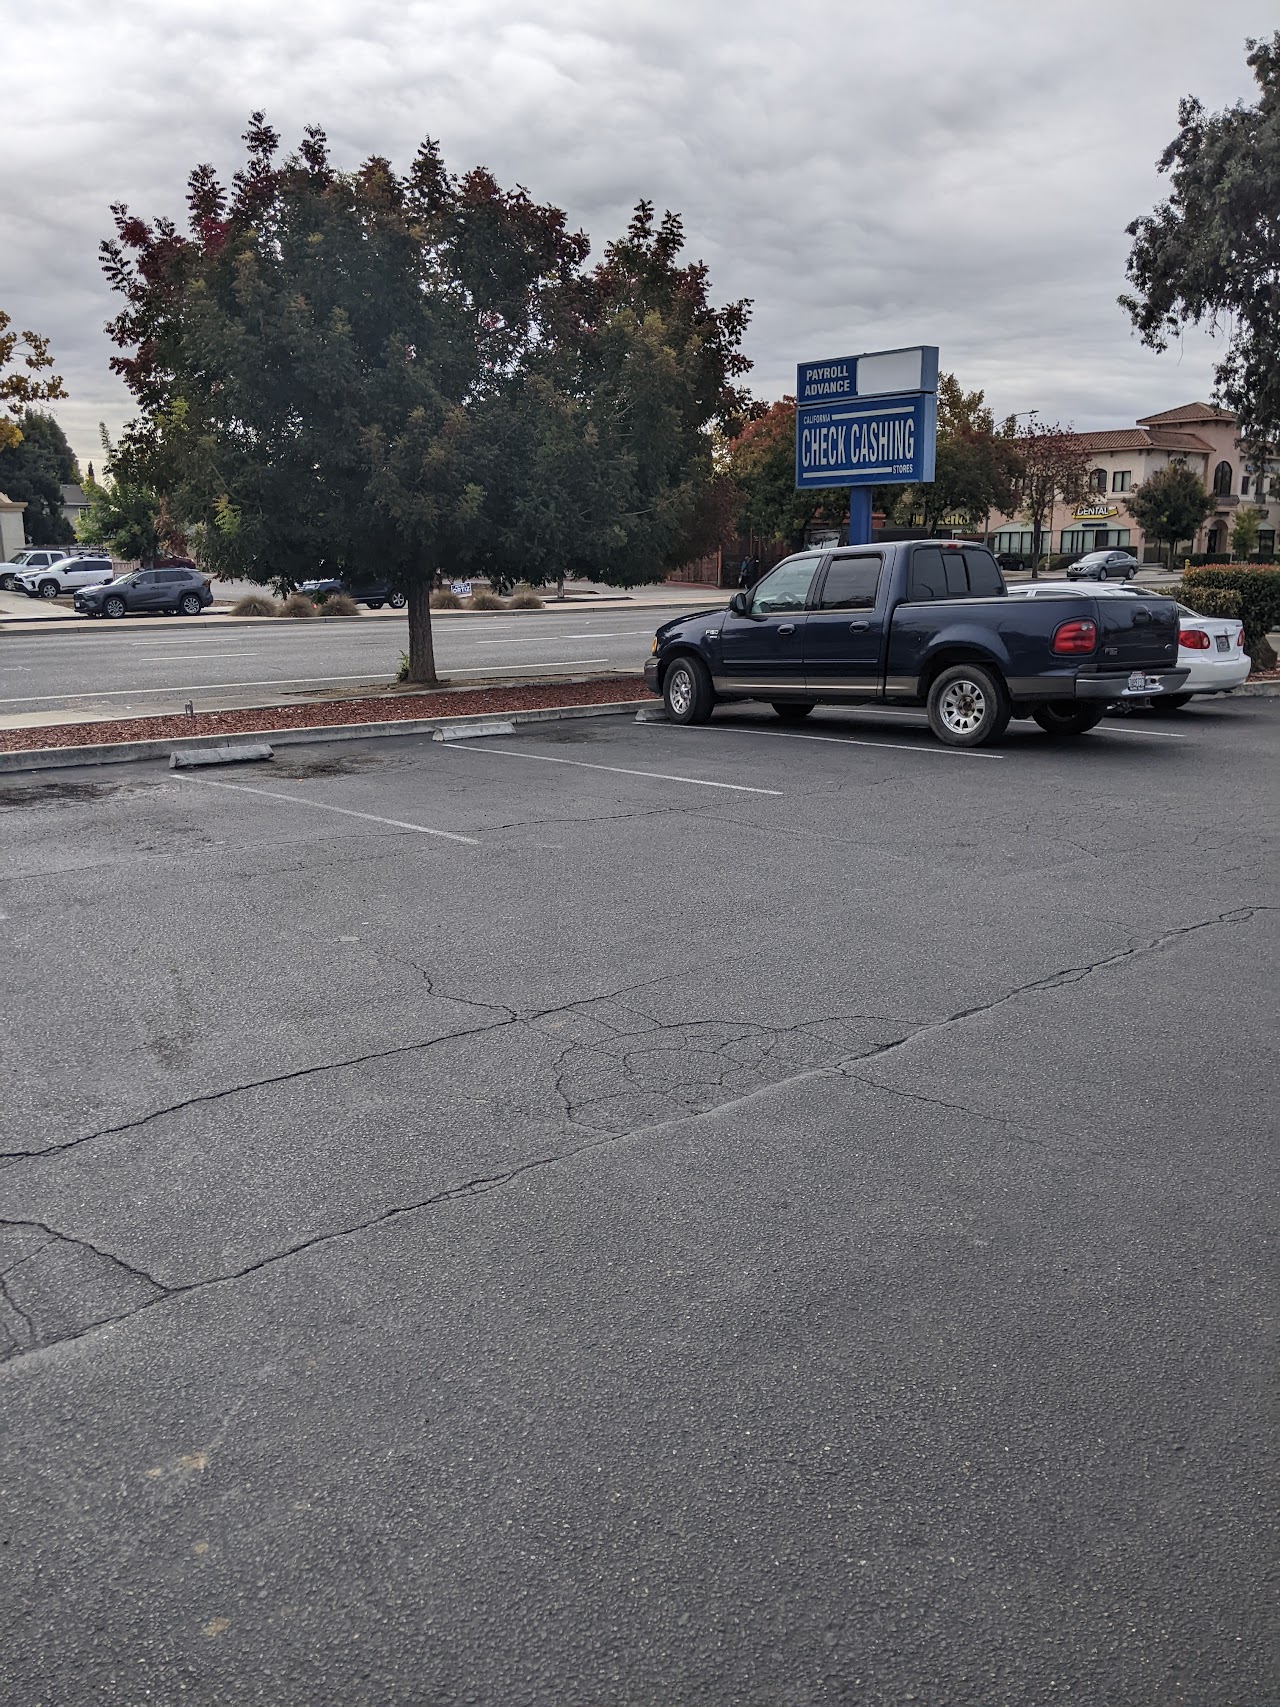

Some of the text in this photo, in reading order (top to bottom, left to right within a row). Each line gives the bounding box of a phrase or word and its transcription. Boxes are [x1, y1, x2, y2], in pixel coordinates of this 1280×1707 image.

[806, 365, 848, 381] PAYROLL
[804, 380, 850, 396] ADVANCE
[803, 413, 831, 425] CALIFORNIA
[802, 418, 914, 467] CHECK CASHING
[892, 464, 913, 474] STORES
[1077, 506, 1109, 515] DENTAL
